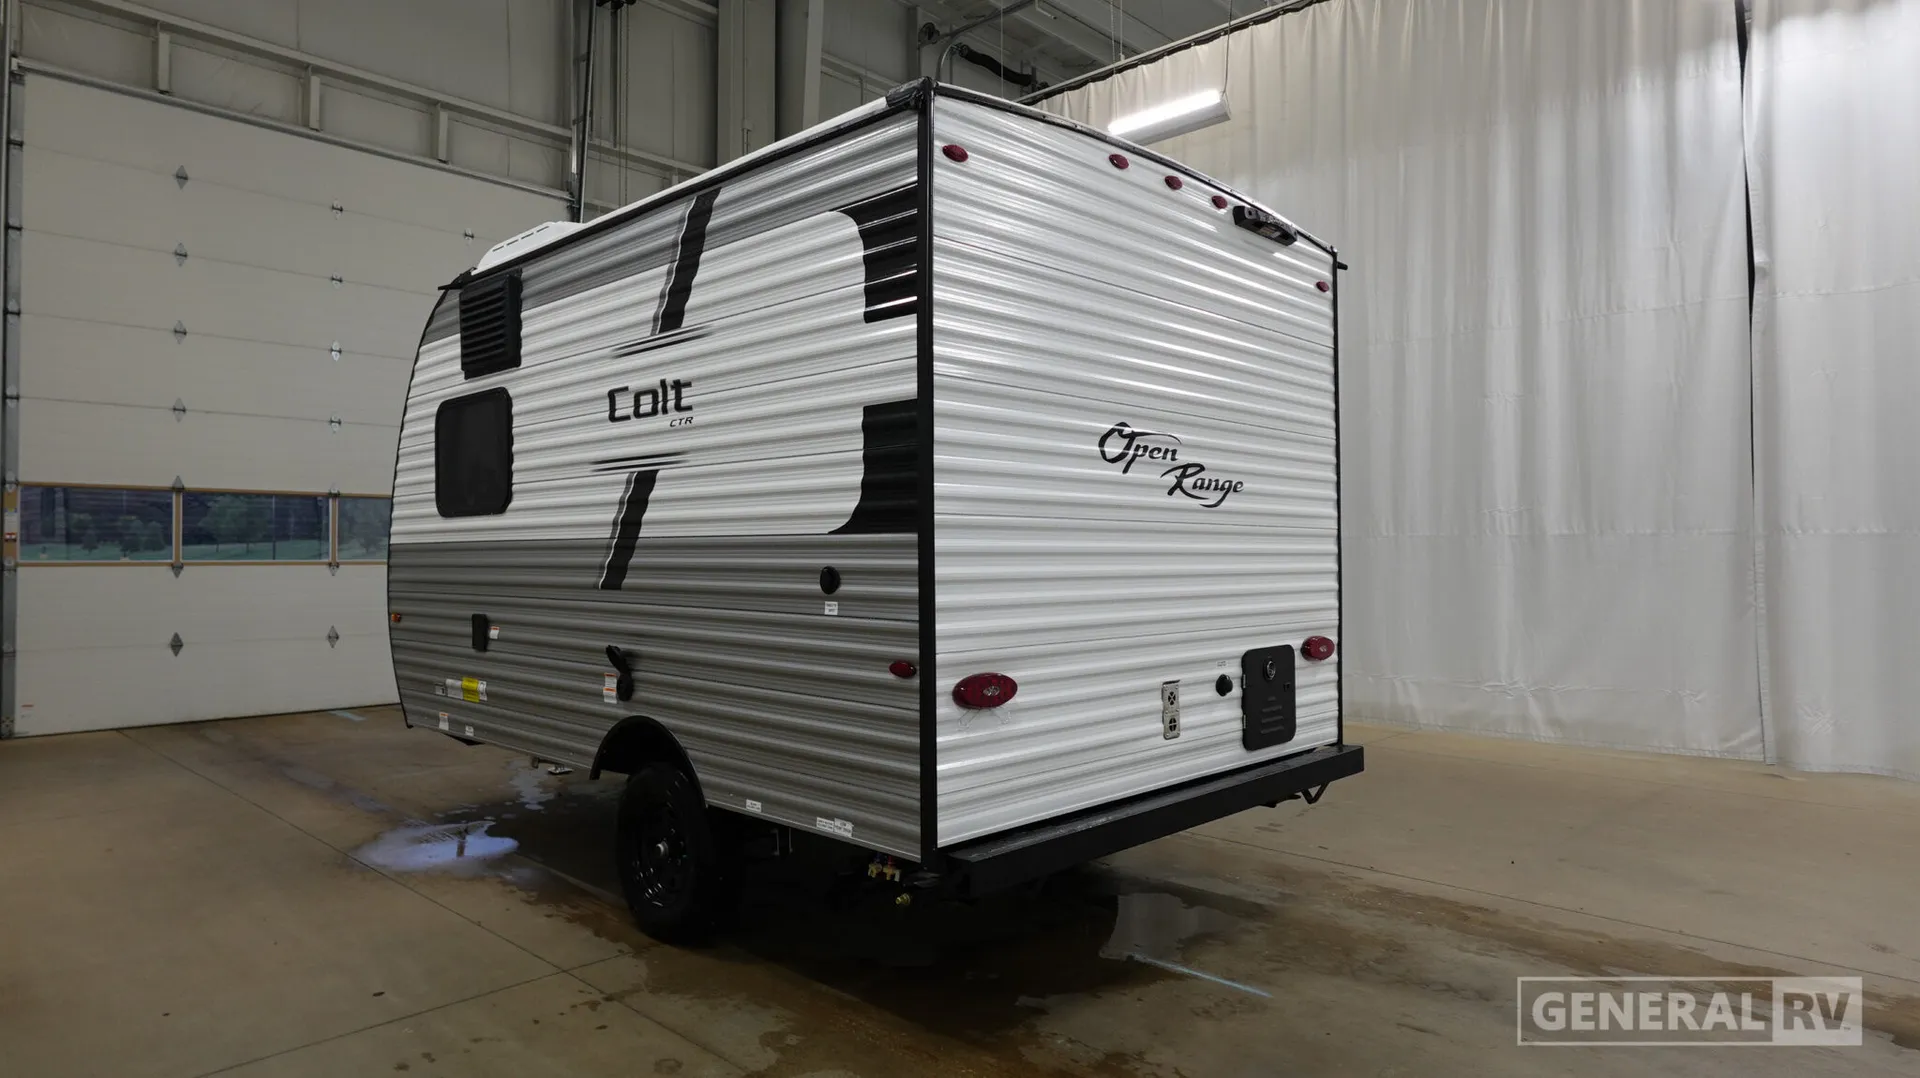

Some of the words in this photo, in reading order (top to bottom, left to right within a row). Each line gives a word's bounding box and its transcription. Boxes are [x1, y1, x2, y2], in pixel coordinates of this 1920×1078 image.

[607, 378, 693, 423] Colt
[669, 416, 694, 428] CTR
[1098, 421, 1182, 474] Open
[1160, 462, 1245, 508] Range
